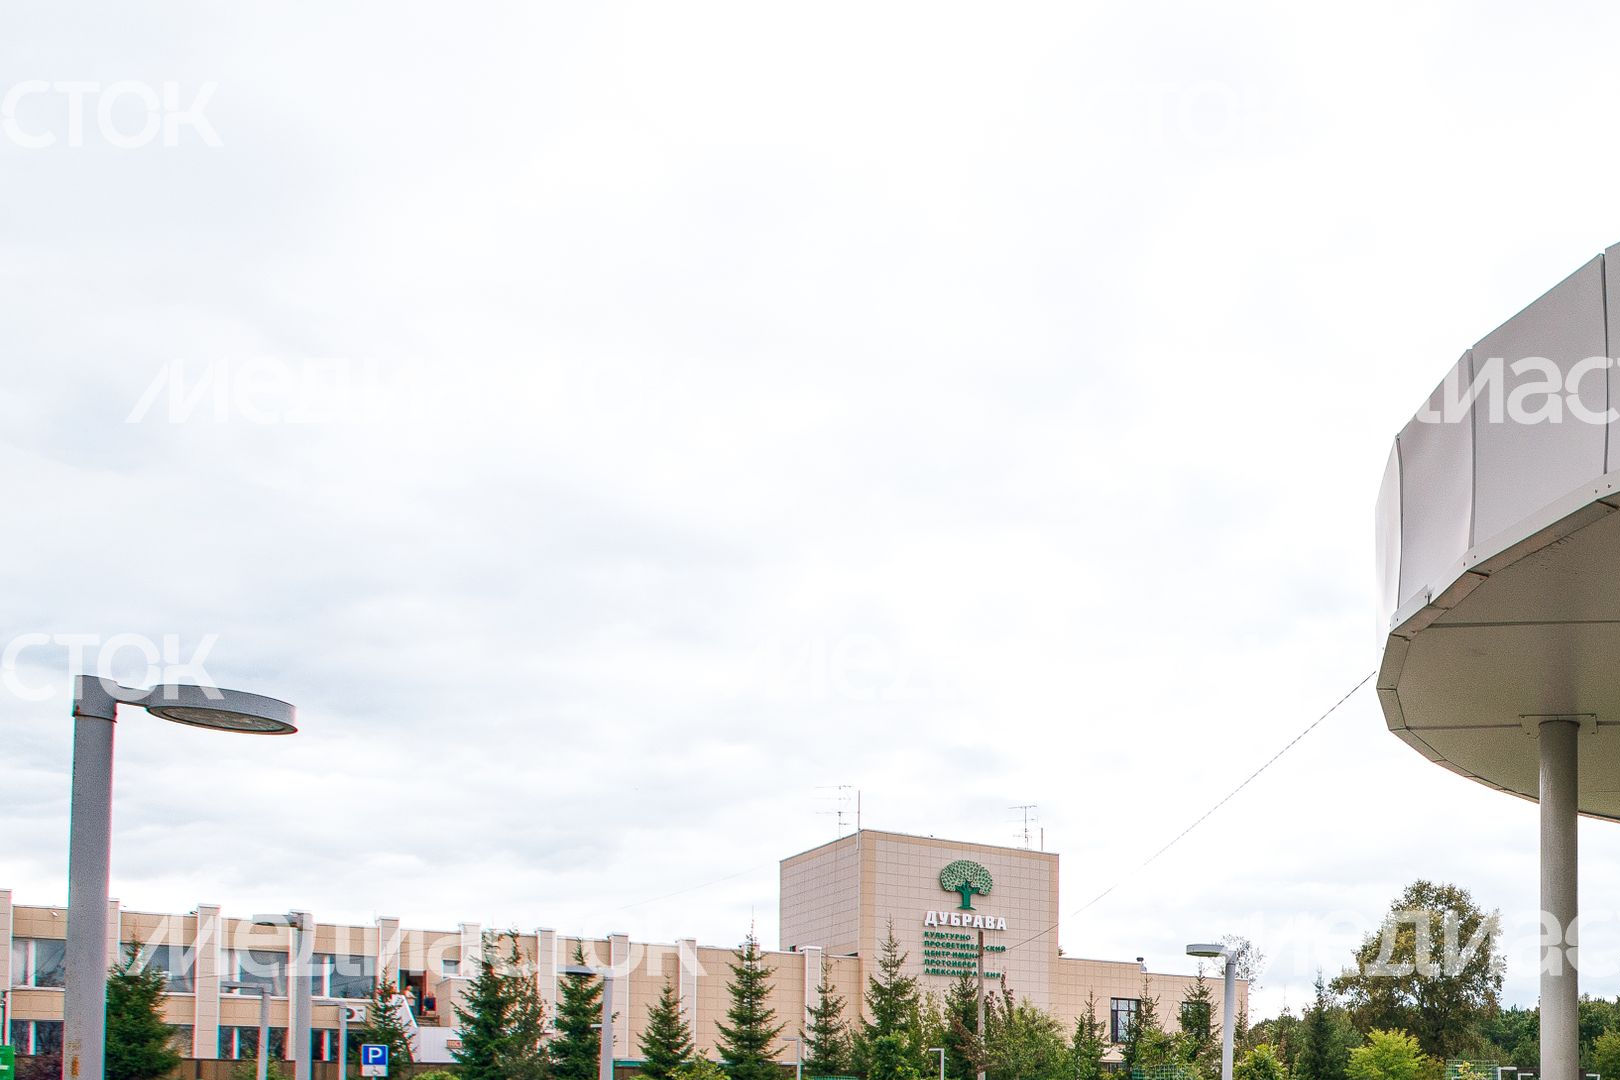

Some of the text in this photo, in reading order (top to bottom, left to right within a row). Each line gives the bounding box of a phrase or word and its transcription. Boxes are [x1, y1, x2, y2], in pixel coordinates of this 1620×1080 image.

[924, 911, 1007, 930] ДУБРАВА
[924, 931, 974, 940] КУЛЬТУРНО-
[924, 940, 1006, 953] ПРОСВЕТИТЕЛСКИЙ
[924, 959, 977, 968] ПРОТОИЕРЕЯ
